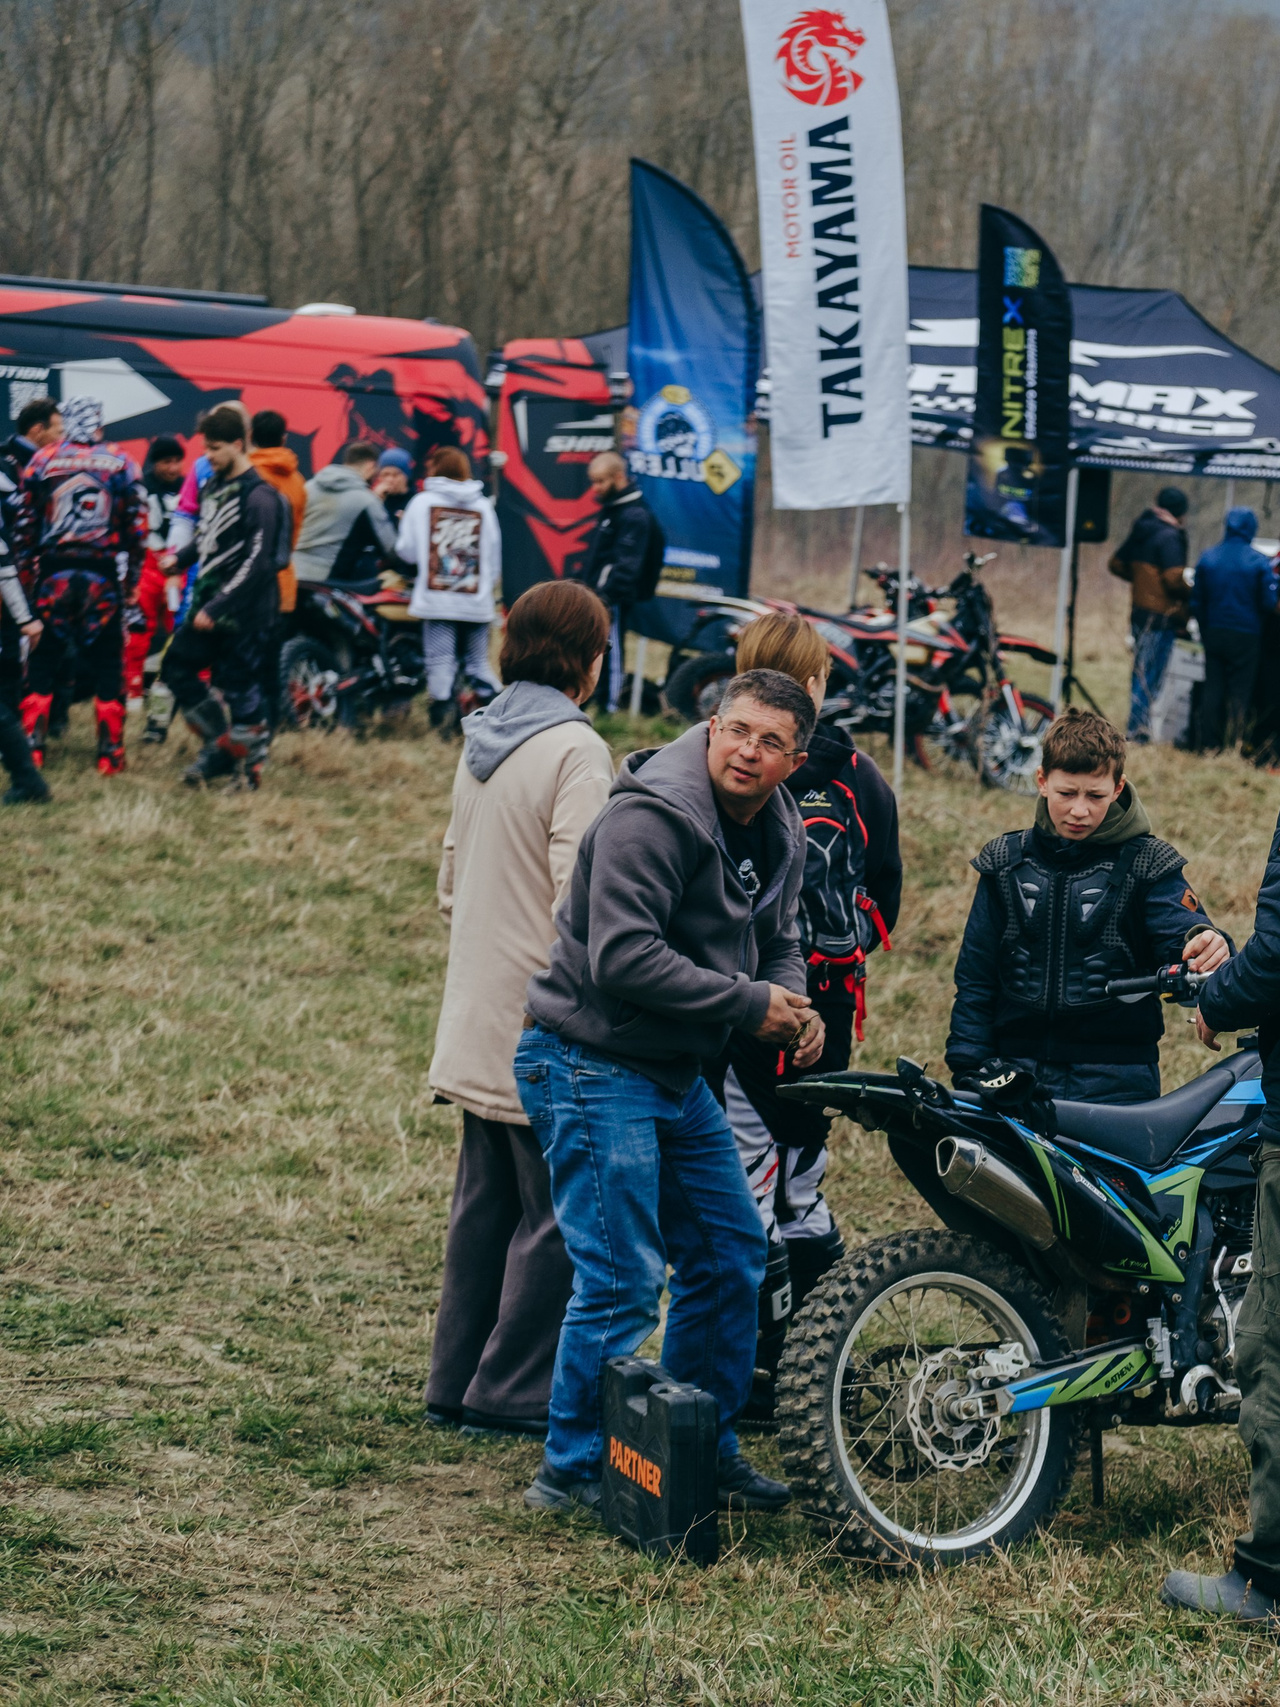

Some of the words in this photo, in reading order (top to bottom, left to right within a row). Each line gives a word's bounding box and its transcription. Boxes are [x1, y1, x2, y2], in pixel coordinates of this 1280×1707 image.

[777, 132, 799, 172] OIL
[781, 178, 802, 259] MOTOR
[806, 115, 864, 439] TAKAYAMA
[1001, 295, 1026, 438] NITREX
[1109, 1361, 1135, 1385] ATHENA
[609, 1436, 662, 1498] PARTNER
